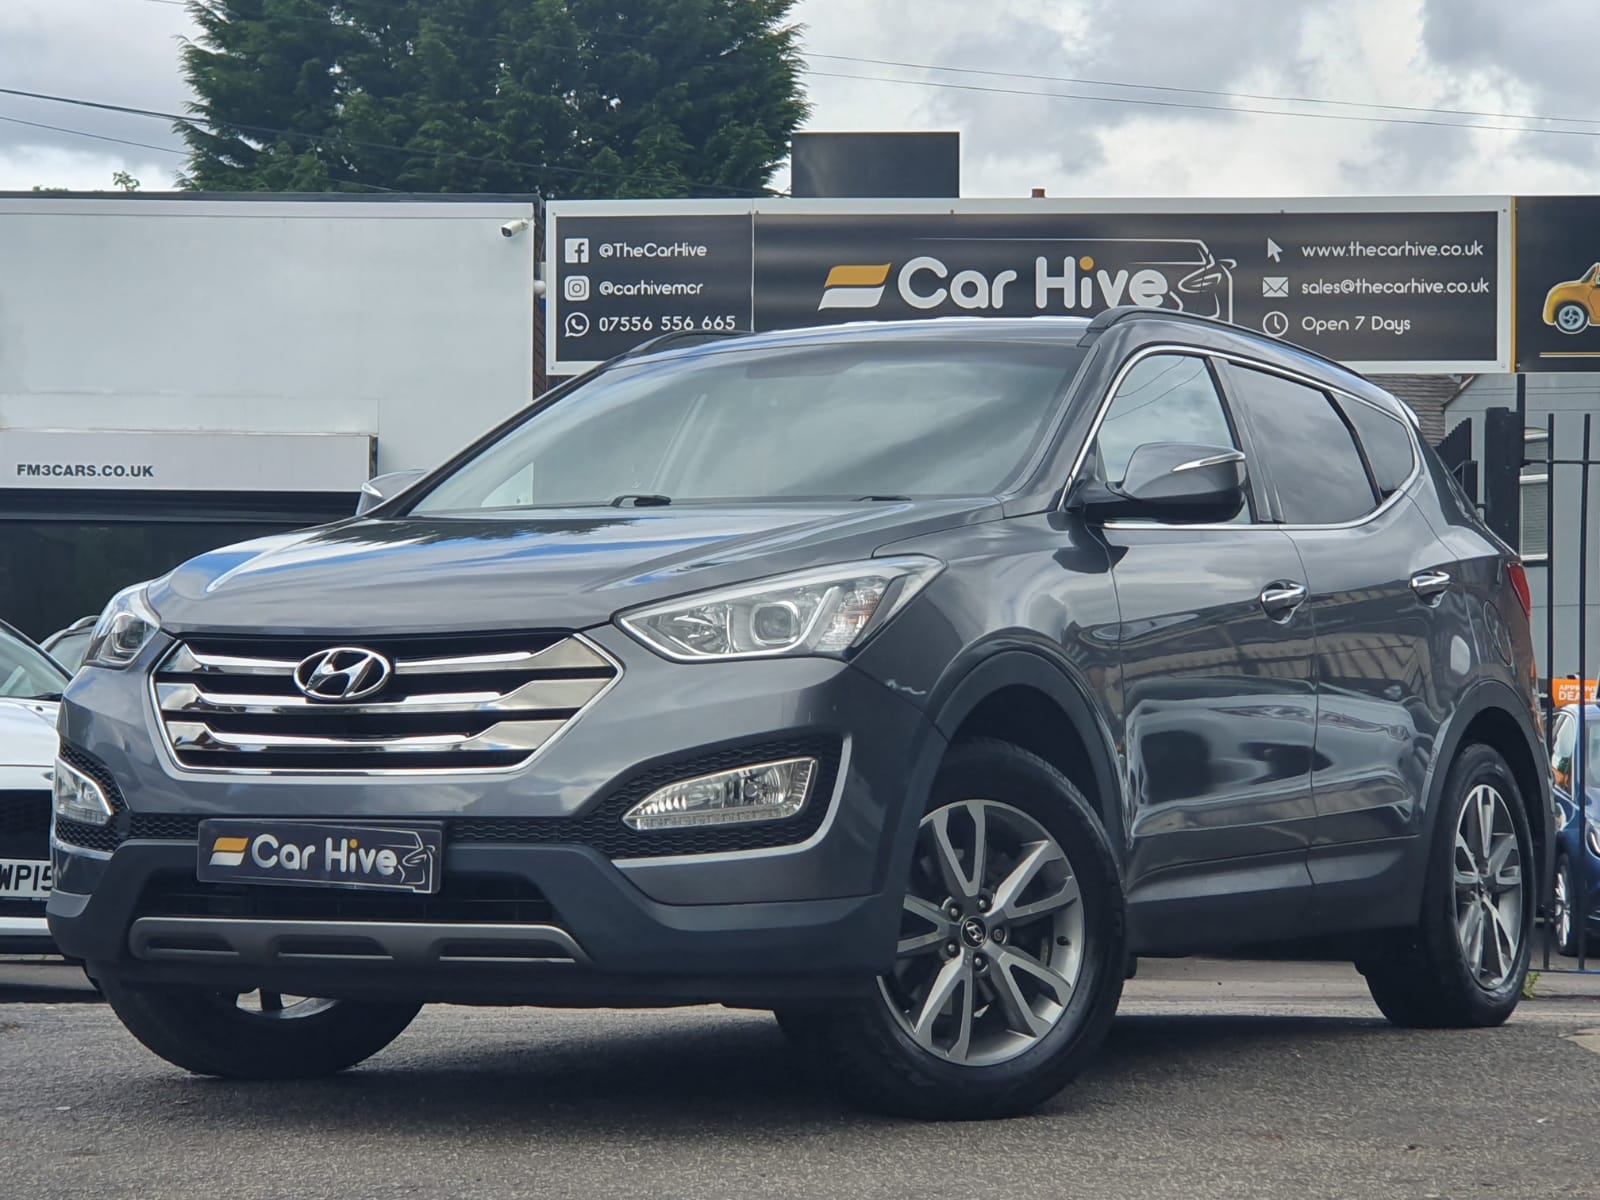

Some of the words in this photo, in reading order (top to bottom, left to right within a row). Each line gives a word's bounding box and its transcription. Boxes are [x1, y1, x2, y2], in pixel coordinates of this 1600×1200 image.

[599, 242, 707, 258] @TheCarHive
[1301, 240, 1484, 257] www.thecarhive.co.uk
[599, 280, 704, 296] @carhivemcr
[897, 255, 1017, 309] Car
[1035, 255, 1169, 308] Hive
[1301, 277, 1490, 295] sales@thecarhive.co.uk
[599, 316, 653, 332] 07556
[660, 316, 694, 331] 556
[701, 315, 736, 330] 665
[1301, 316, 1350, 335] Open
[1354, 315, 1366, 331] 7
[1371, 315, 1411, 335] Days
[16, 464, 154, 478] FM3CARS.CO.UK
[251, 834, 316, 870] Car
[325, 837, 398, 876] Hive
